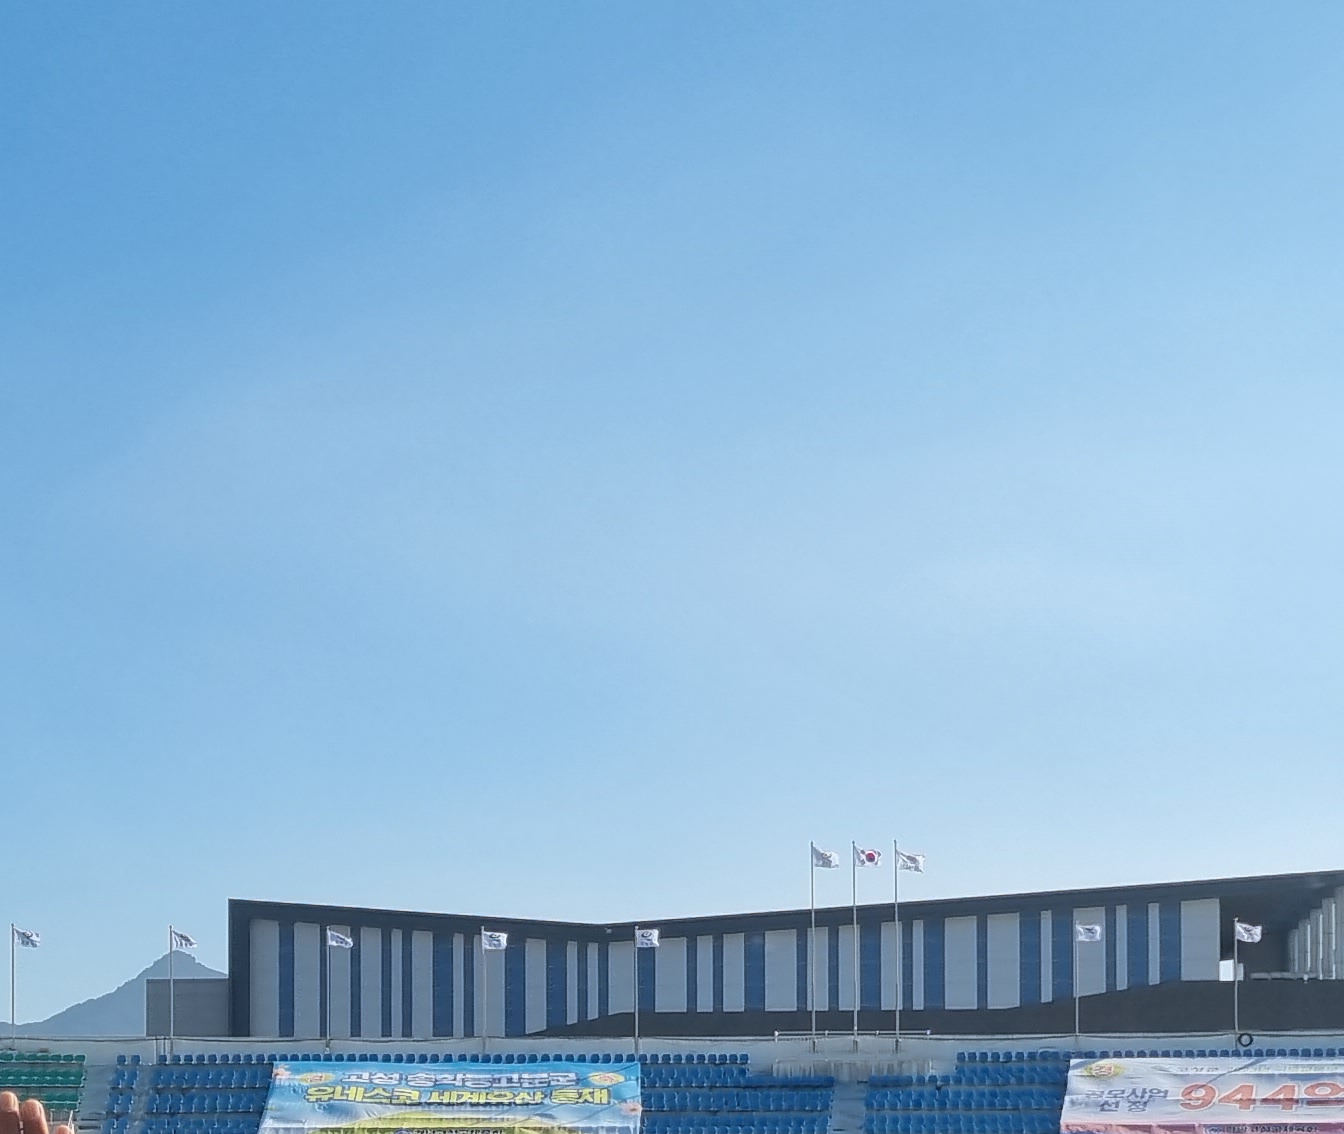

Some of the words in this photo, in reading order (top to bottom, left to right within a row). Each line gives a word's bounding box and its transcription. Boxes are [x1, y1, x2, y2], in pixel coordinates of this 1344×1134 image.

[341, 1072, 400, 1086] 고성
[304, 1086, 420, 1104] 유네스코
[426, 1089, 544, 1105] 세계유산
[549, 1088, 610, 1105] 등재
[1098, 1100, 1149, 1113] 선정
